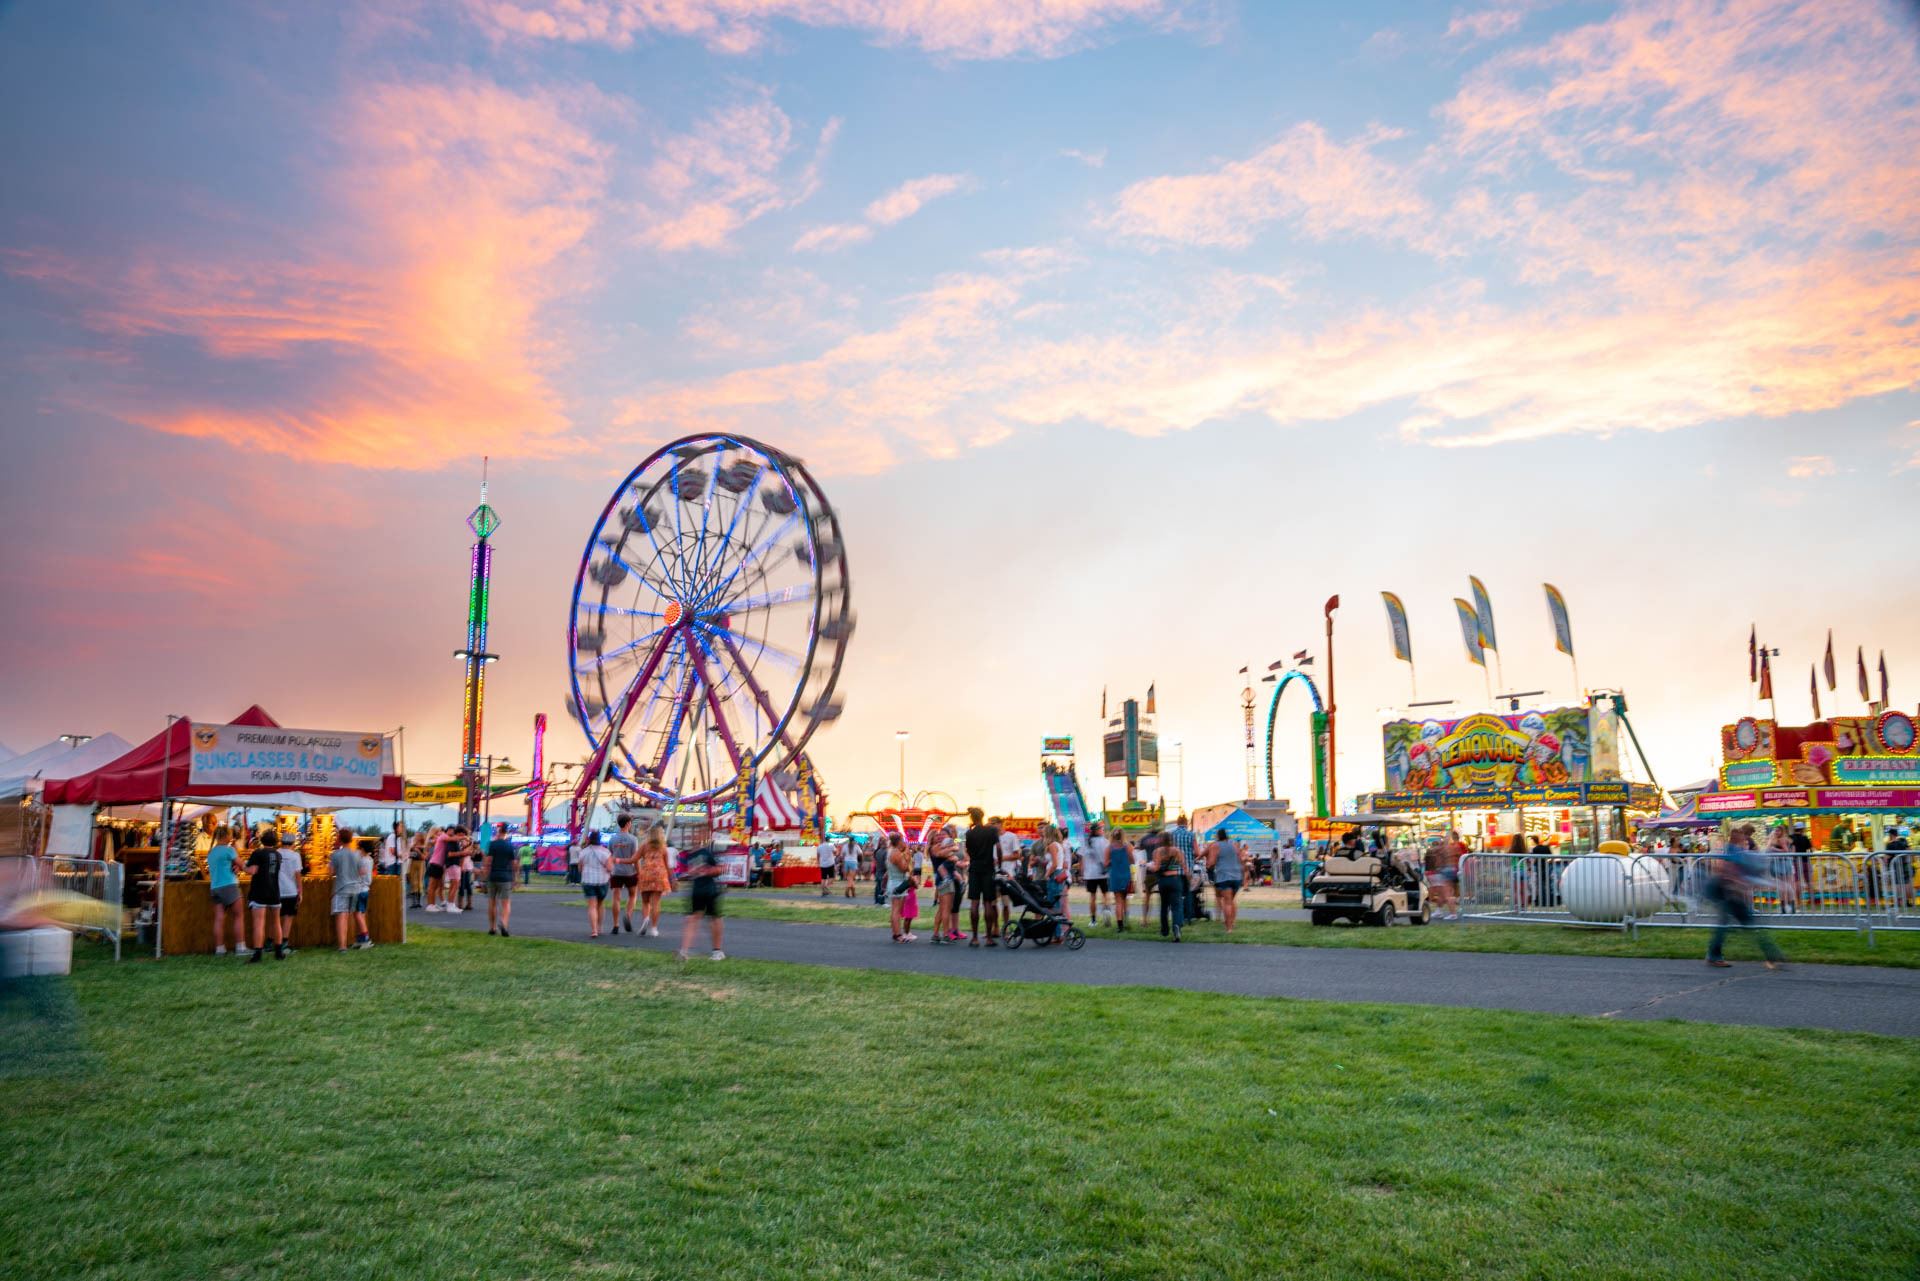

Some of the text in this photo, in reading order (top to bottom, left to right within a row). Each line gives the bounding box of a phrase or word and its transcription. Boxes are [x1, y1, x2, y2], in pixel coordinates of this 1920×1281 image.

[236, 732, 342, 748] PREMIUM POLARIZED
[1441, 732, 1526, 769] LEMONADE
[193, 751, 379, 777] SUNGLASSES & CLIP-ONS
[251, 770, 329, 783] FOR A LOT LESS
[1375, 798, 1415, 808] Shaved
[1441, 792, 1507, 805] Lemonade
[1511, 791, 1543, 802] Snow
[1544, 789, 1581, 801] Cones
[1587, 792, 1627, 802] DRINKS
